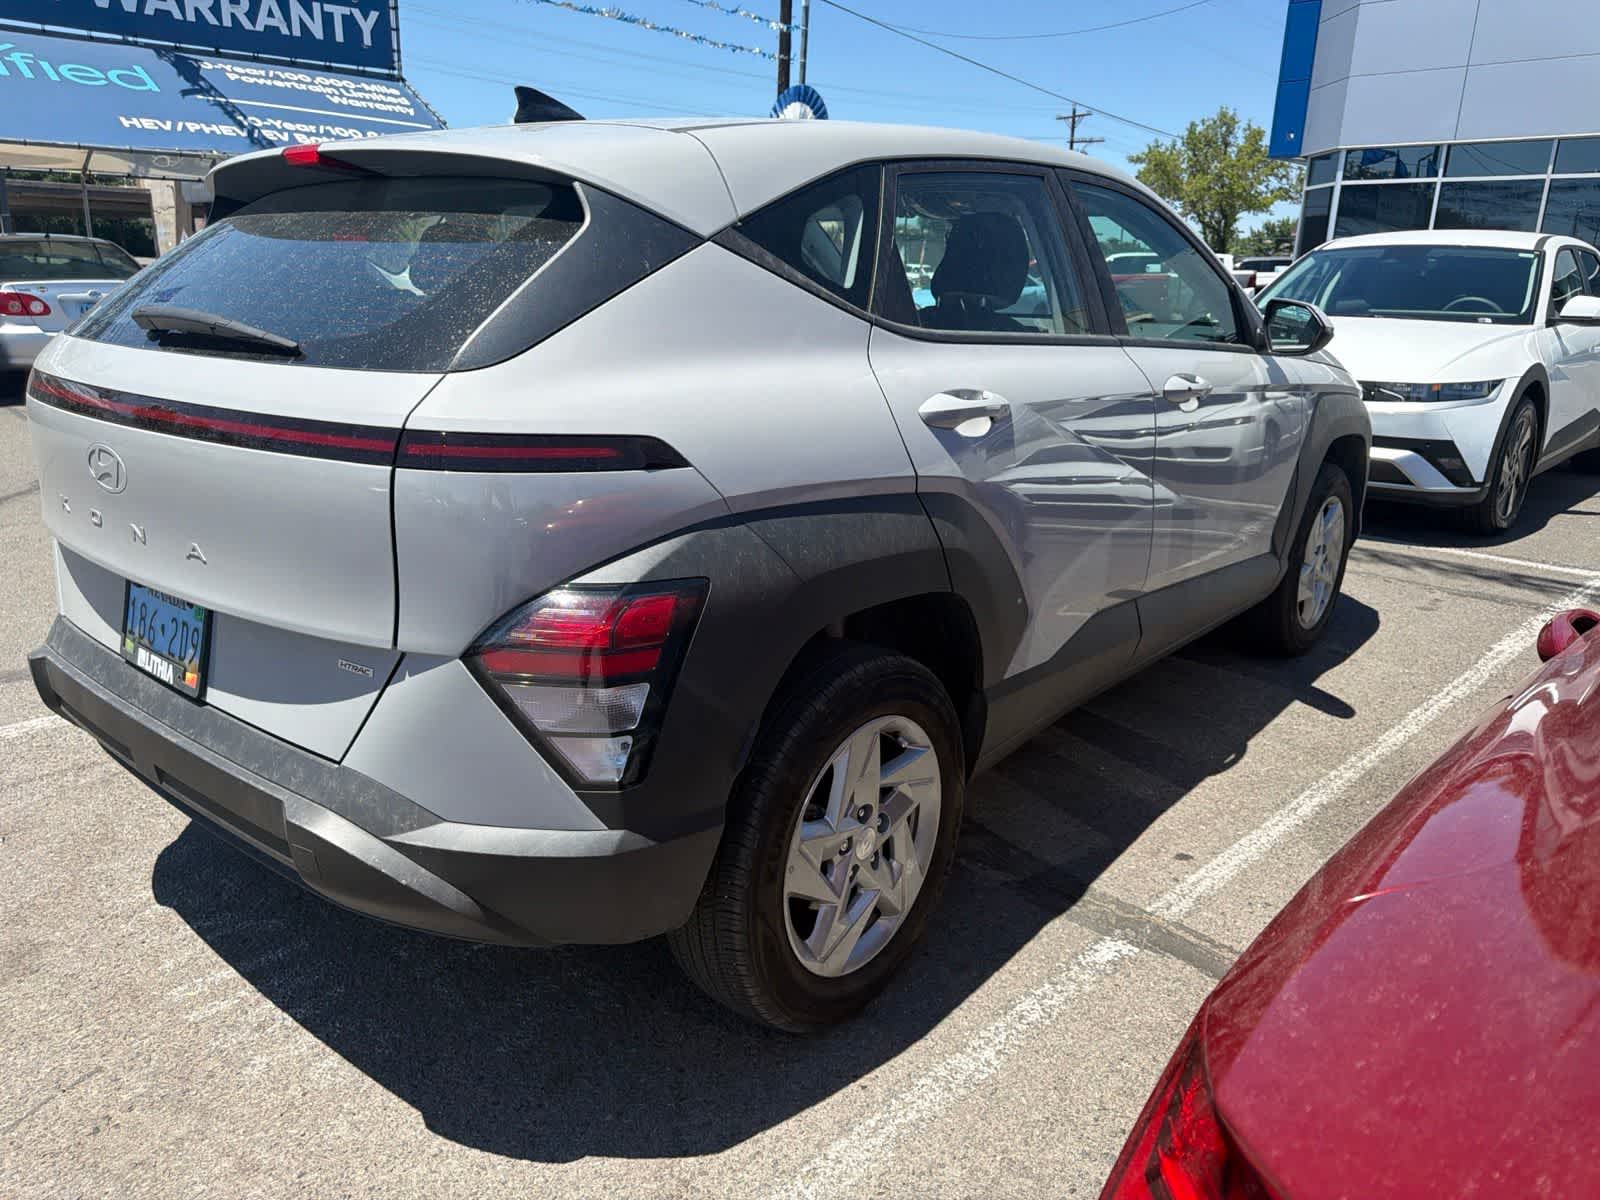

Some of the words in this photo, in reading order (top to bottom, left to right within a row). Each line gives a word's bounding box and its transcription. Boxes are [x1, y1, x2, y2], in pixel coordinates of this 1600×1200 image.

[94, 0, 380, 47] ARRANTY
[225, 71, 340, 96] Powertrain
[340, 87, 411, 106] Limited
[325, 94, 415, 117] Warranty
[60, 493, 207, 565] KONA
